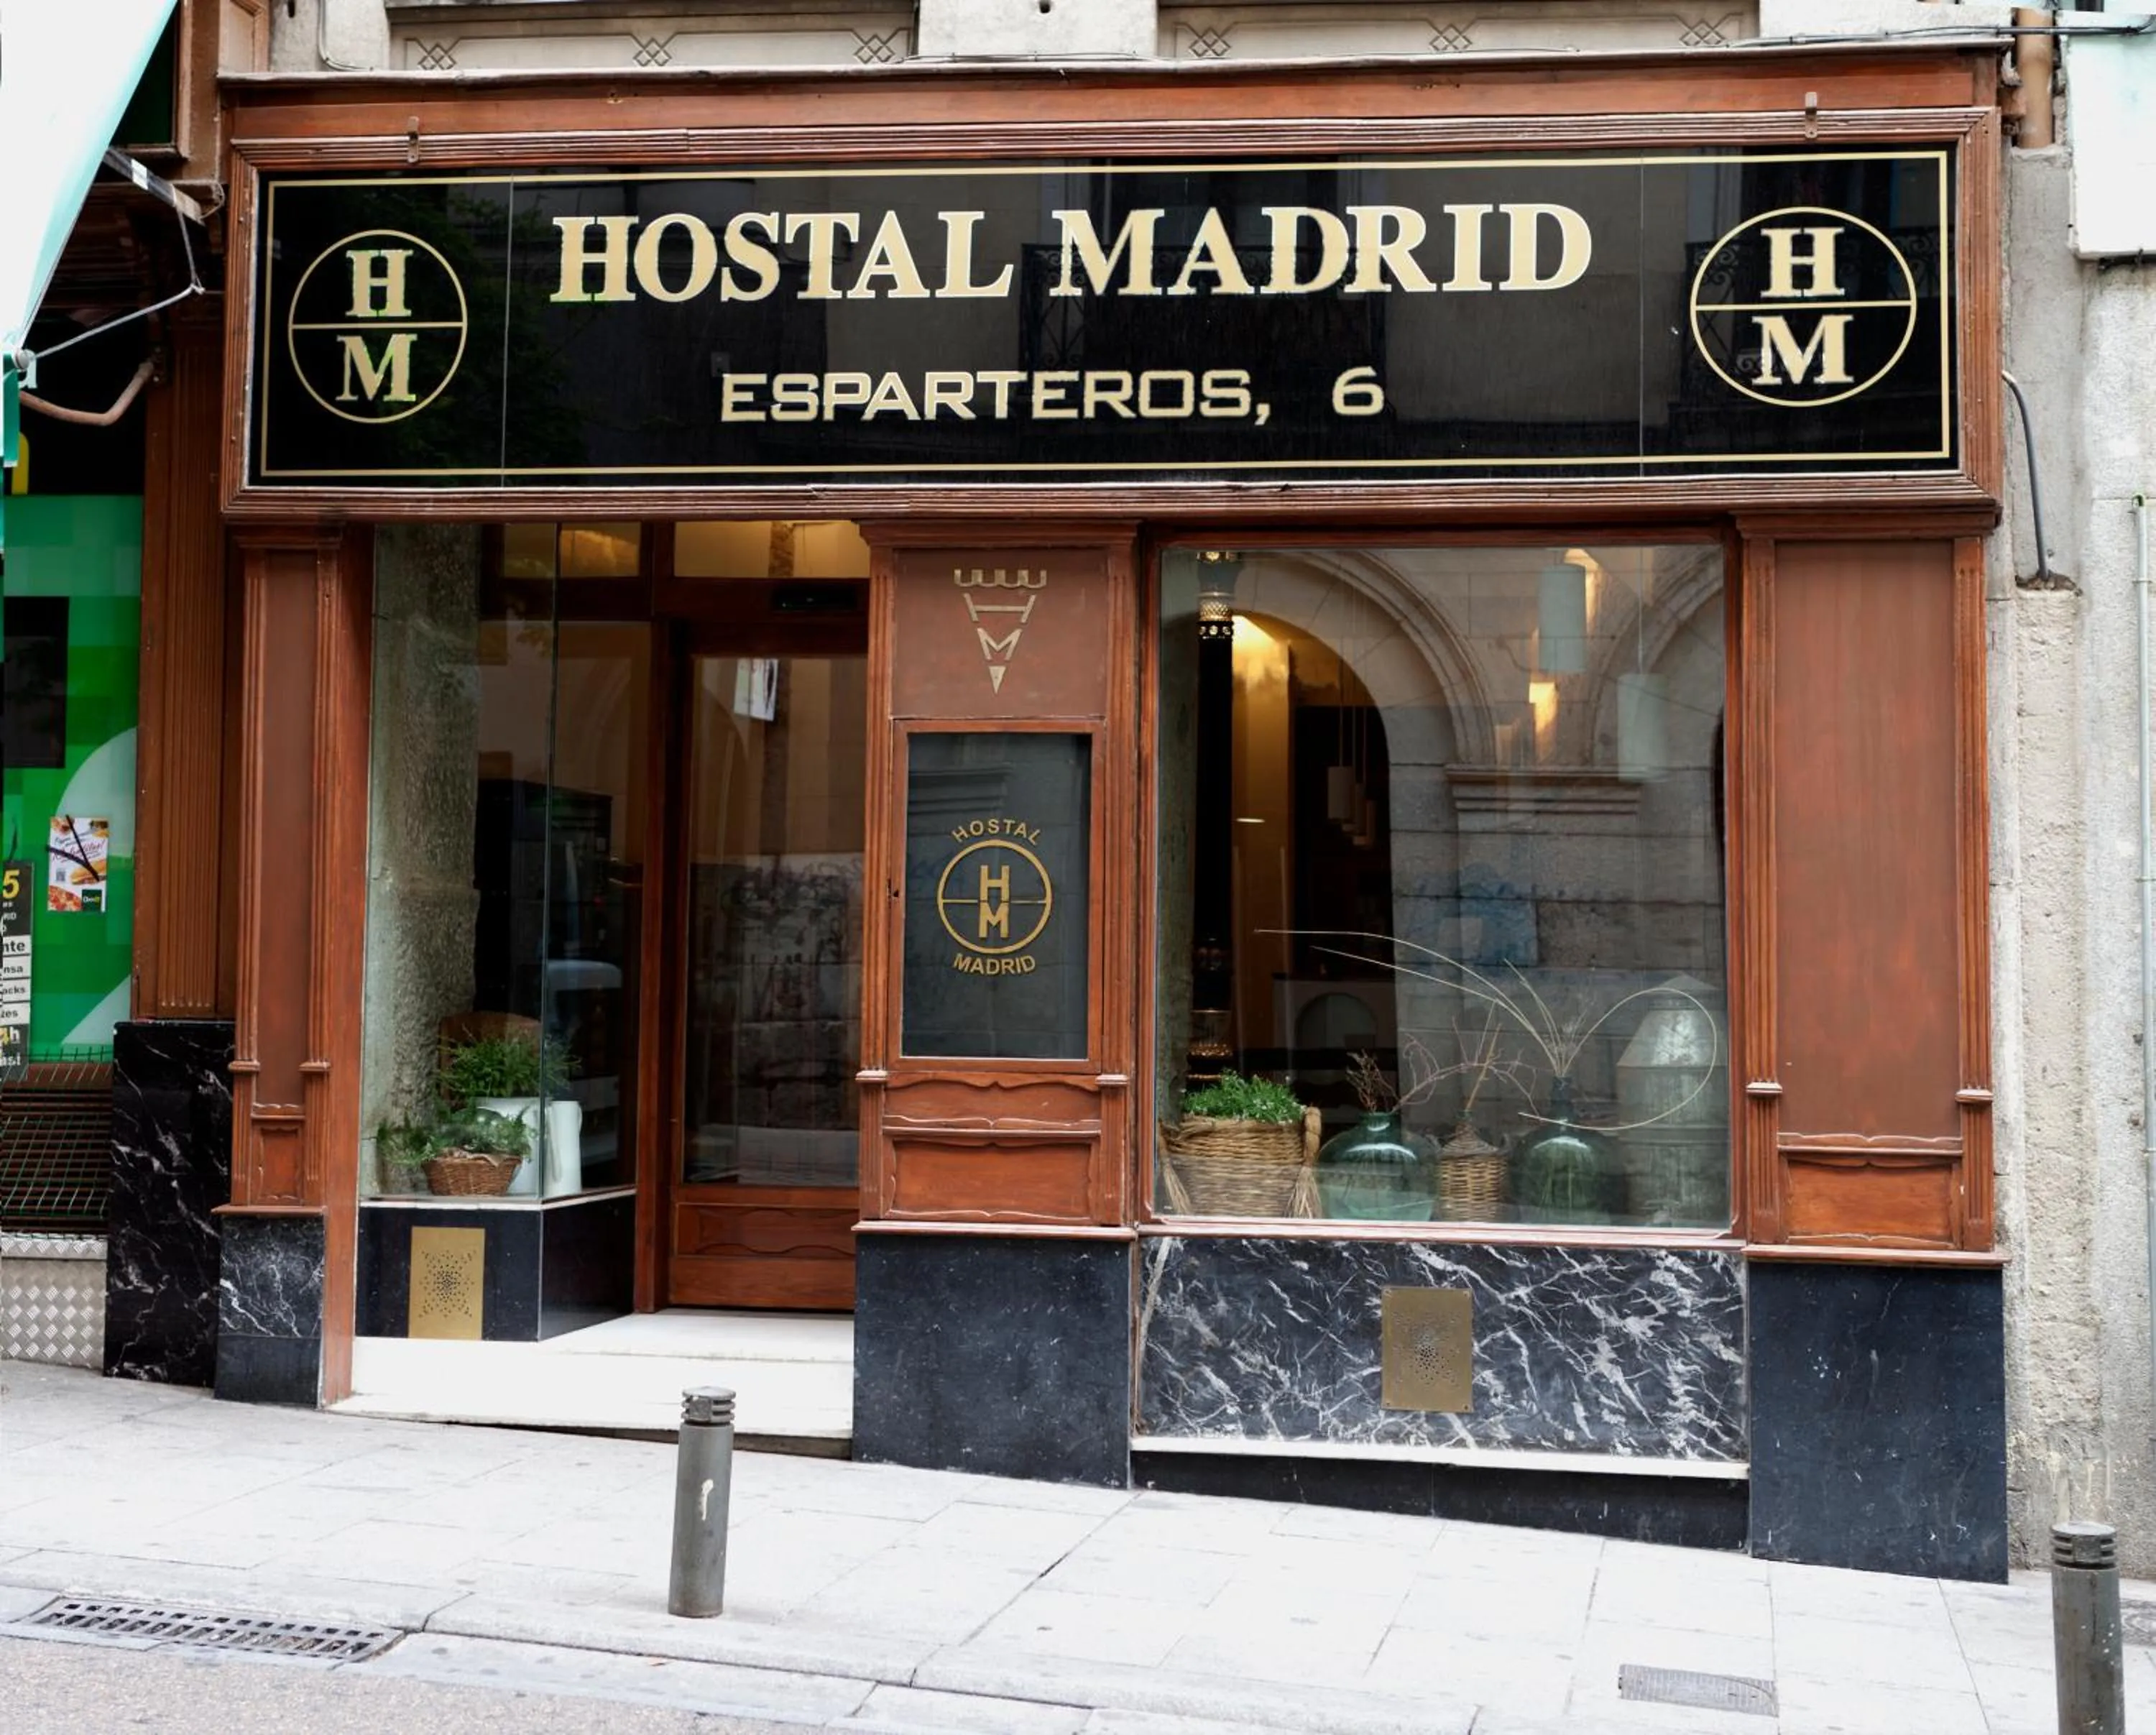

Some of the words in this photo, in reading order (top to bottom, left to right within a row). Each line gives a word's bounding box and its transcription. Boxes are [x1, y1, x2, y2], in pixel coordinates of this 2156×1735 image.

[346, 249, 413, 317] H
[549, 209, 1014, 303] HOSTAL
[1049, 203, 1593, 297] MADRID
[1760, 226, 1846, 298] H
[335, 333, 417, 402] M
[1751, 314, 1853, 385] M
[721, 369, 1270, 425] ESPARTEROS,
[1332, 365, 1385, 416] 6
[951, 818, 1041, 846] HOSTAL
[2, 869, 20, 898] 5
[953, 952, 1036, 975] MADRID
